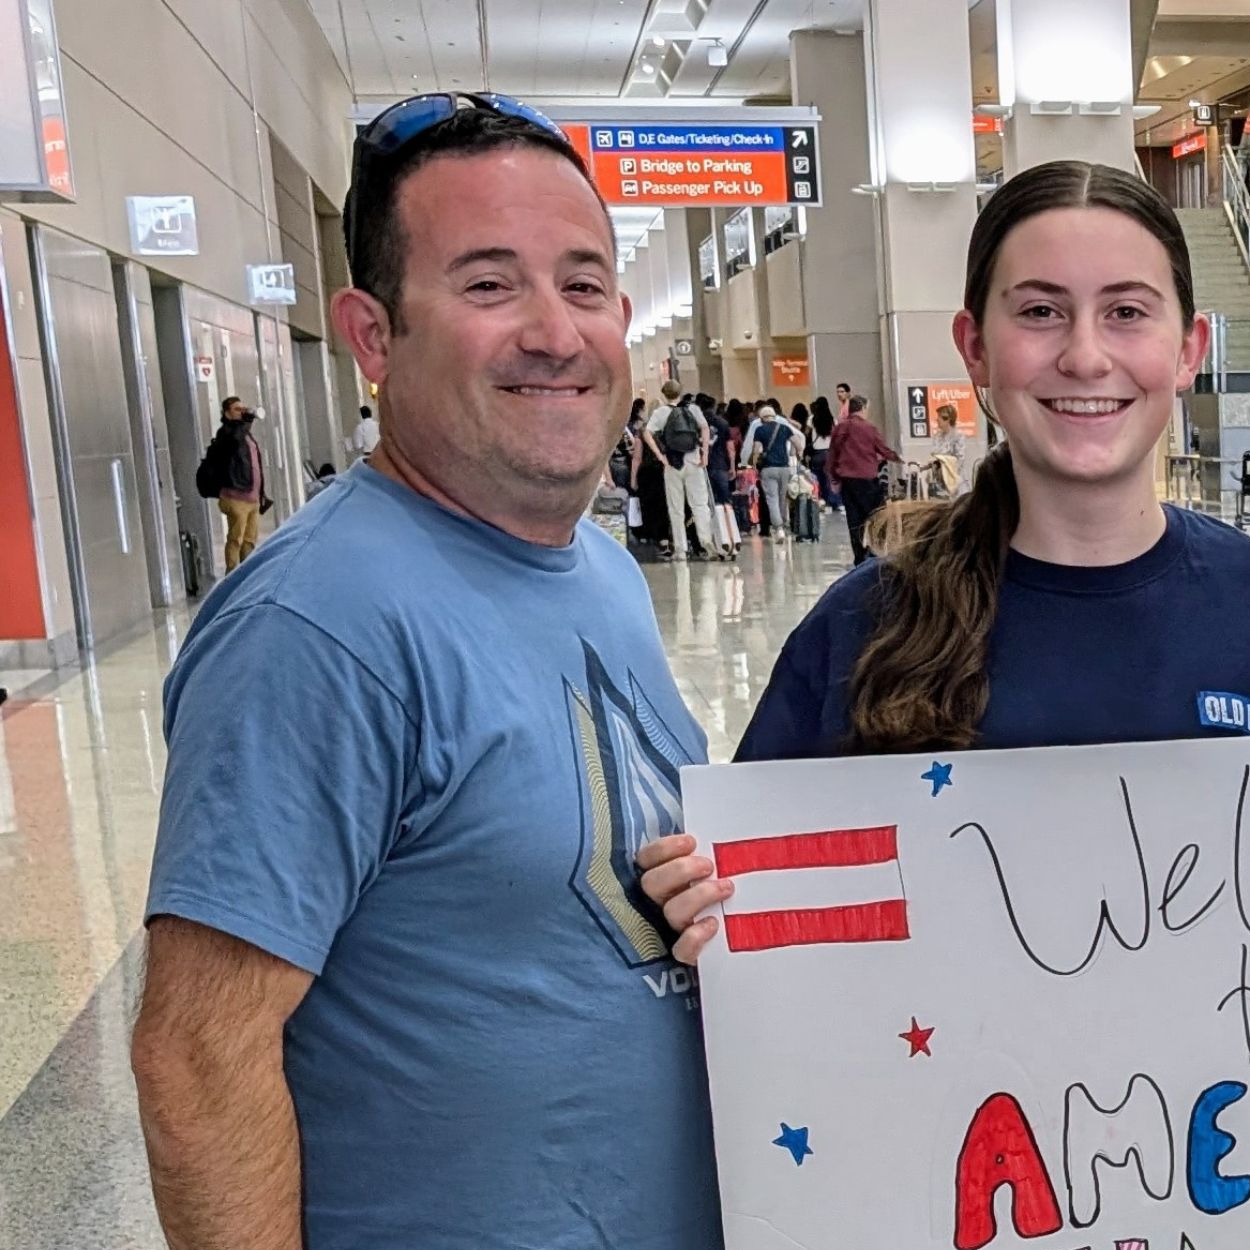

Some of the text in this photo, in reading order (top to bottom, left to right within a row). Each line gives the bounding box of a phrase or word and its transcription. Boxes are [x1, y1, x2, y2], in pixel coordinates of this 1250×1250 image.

[640, 159, 753, 175] Bridge to Parking
[642, 181, 764, 196] Passenger Pick Up
[1204, 695, 1245, 726] OLD
